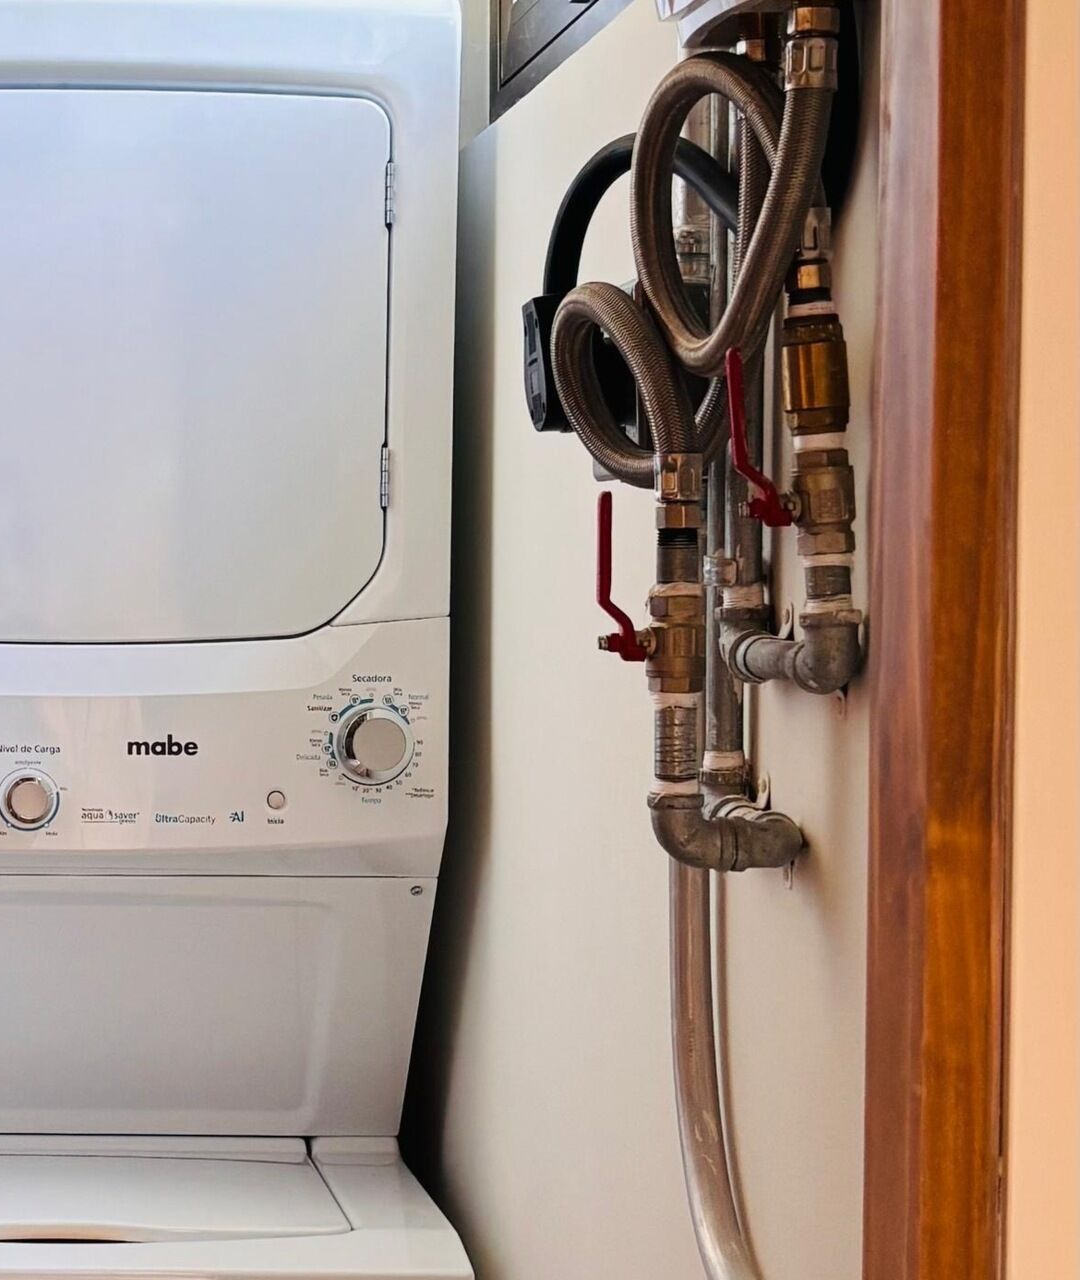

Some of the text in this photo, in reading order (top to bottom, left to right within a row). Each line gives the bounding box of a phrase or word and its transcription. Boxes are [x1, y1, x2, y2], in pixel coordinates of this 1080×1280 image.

[352, 674, 392, 683] Secadora
[21, 744, 32, 753] de
[34, 745, 61, 755] Carga
[127, 734, 198, 756] mabe
[81, 811, 104, 820] aqua
[155, 813, 216, 825] UltraCapacity
